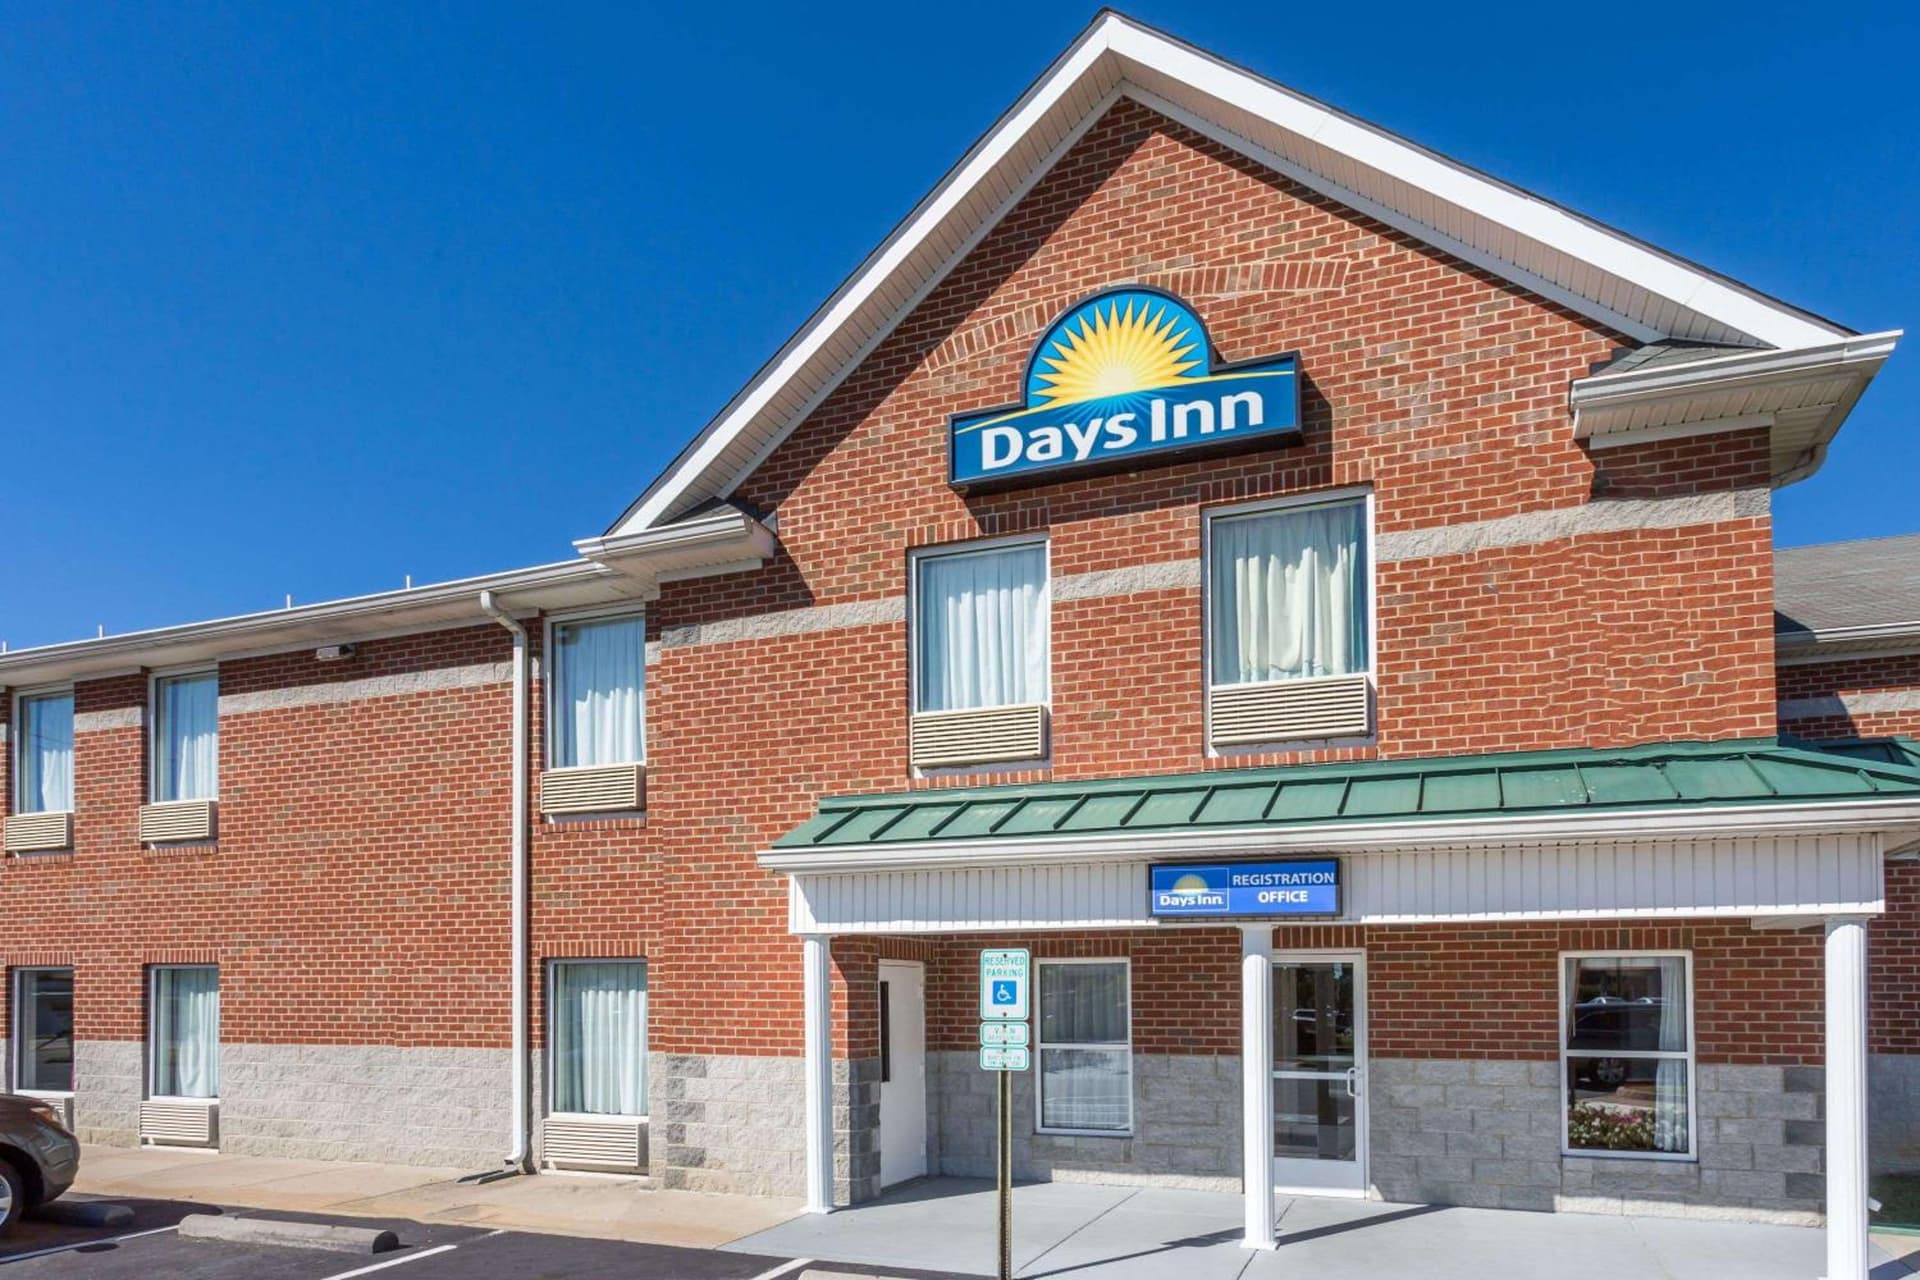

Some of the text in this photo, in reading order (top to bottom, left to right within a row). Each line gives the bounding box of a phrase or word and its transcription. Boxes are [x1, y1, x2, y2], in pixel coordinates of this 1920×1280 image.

[981, 390, 1264, 471] Days Inn
[1232, 872, 1335, 886] REGISTRATION
[1160, 894, 1223, 907] Days Inn
[1258, 890, 1309, 904] OFFICE
[984, 957, 1025, 966] RESERVED
[986, 968, 1024, 977] PARKING
